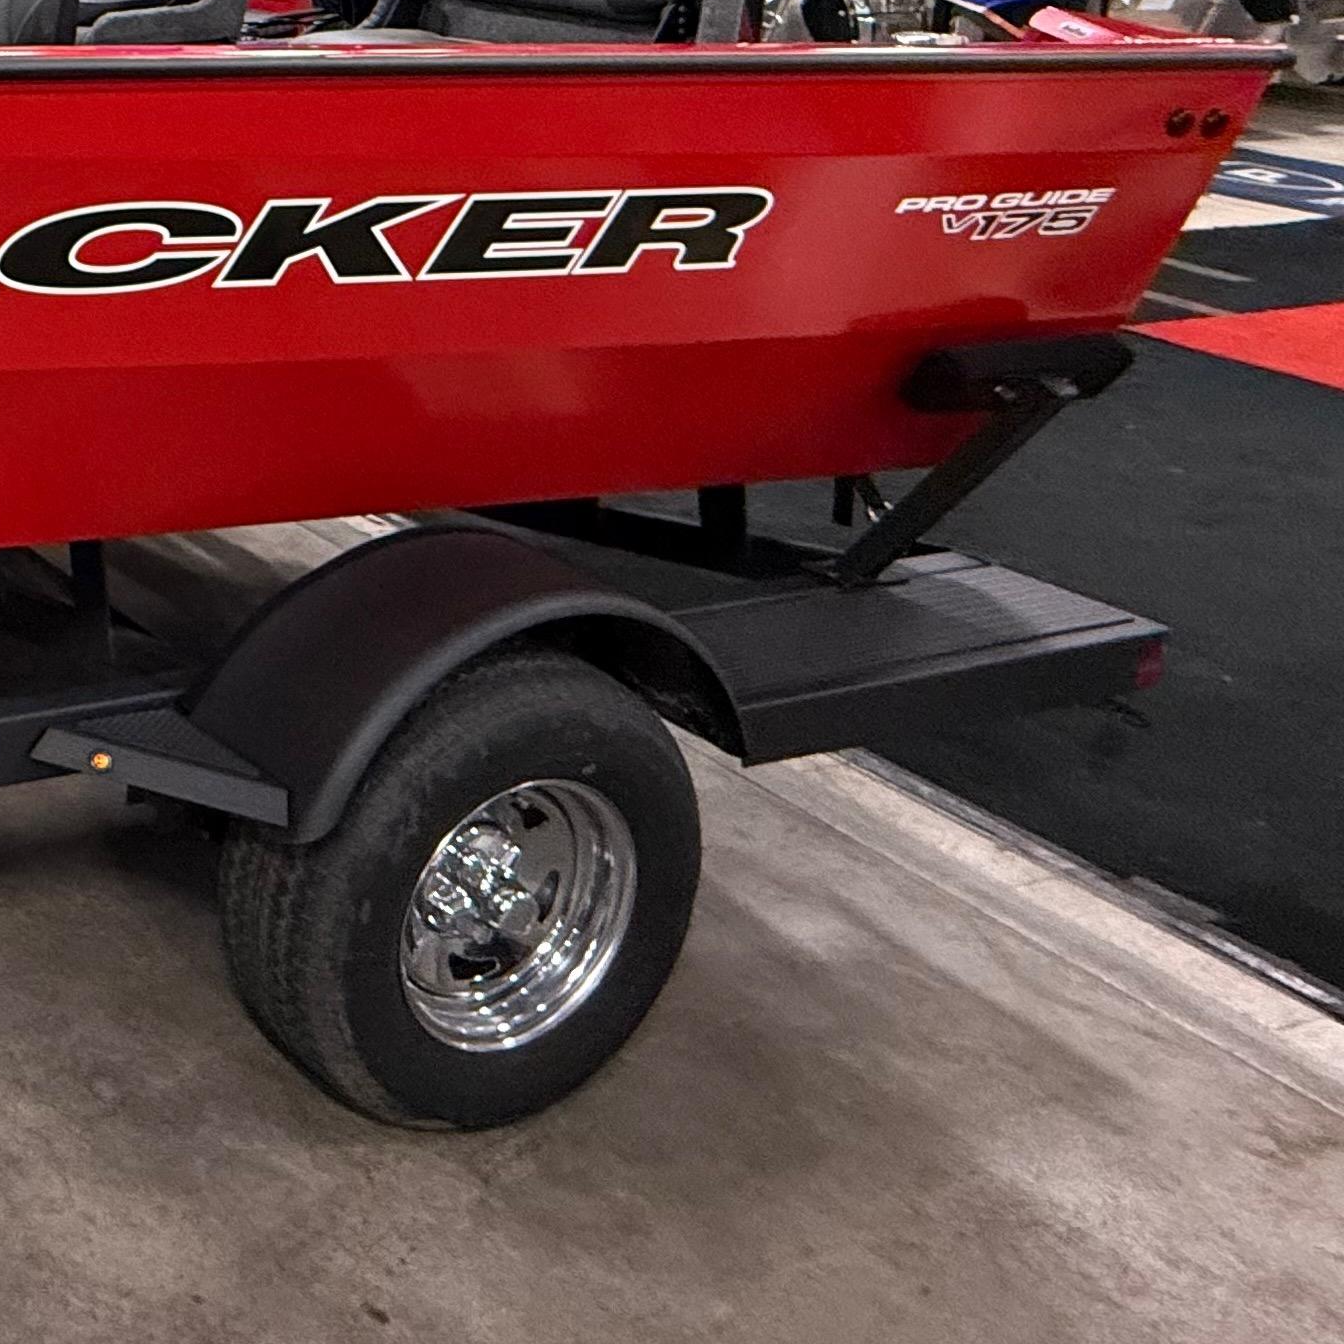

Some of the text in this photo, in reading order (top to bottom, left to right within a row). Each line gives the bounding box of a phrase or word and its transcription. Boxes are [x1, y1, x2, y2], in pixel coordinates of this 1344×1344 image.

[894, 187, 1117, 214] PRO GUIDE
[942, 205, 1099, 241] V175
